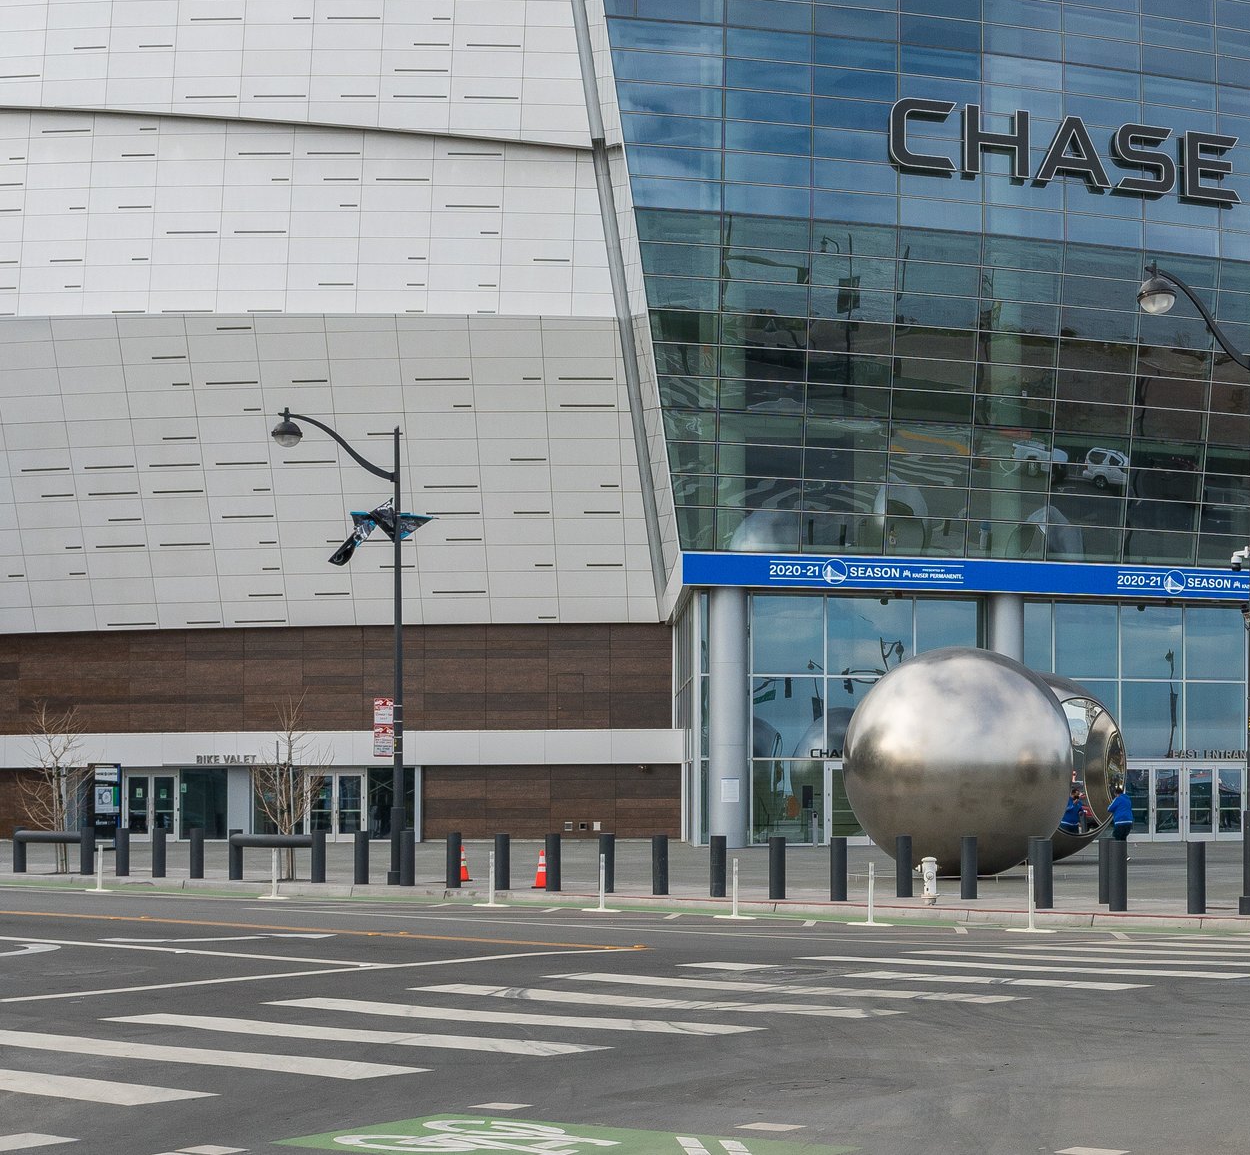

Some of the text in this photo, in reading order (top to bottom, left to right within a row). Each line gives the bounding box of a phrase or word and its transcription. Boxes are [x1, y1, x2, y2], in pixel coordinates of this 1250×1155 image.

[890, 97, 1242, 205] CHASE
[770, 565, 899, 578] 2020-21 SEASON
[1117, 575, 1231, 588] 2020-21 SEASON
[196, 754, 256, 764] BIKE VALET
[810, 749, 843, 758] CHA
[1171, 750, 1247, 759] EAST ENTRAN
